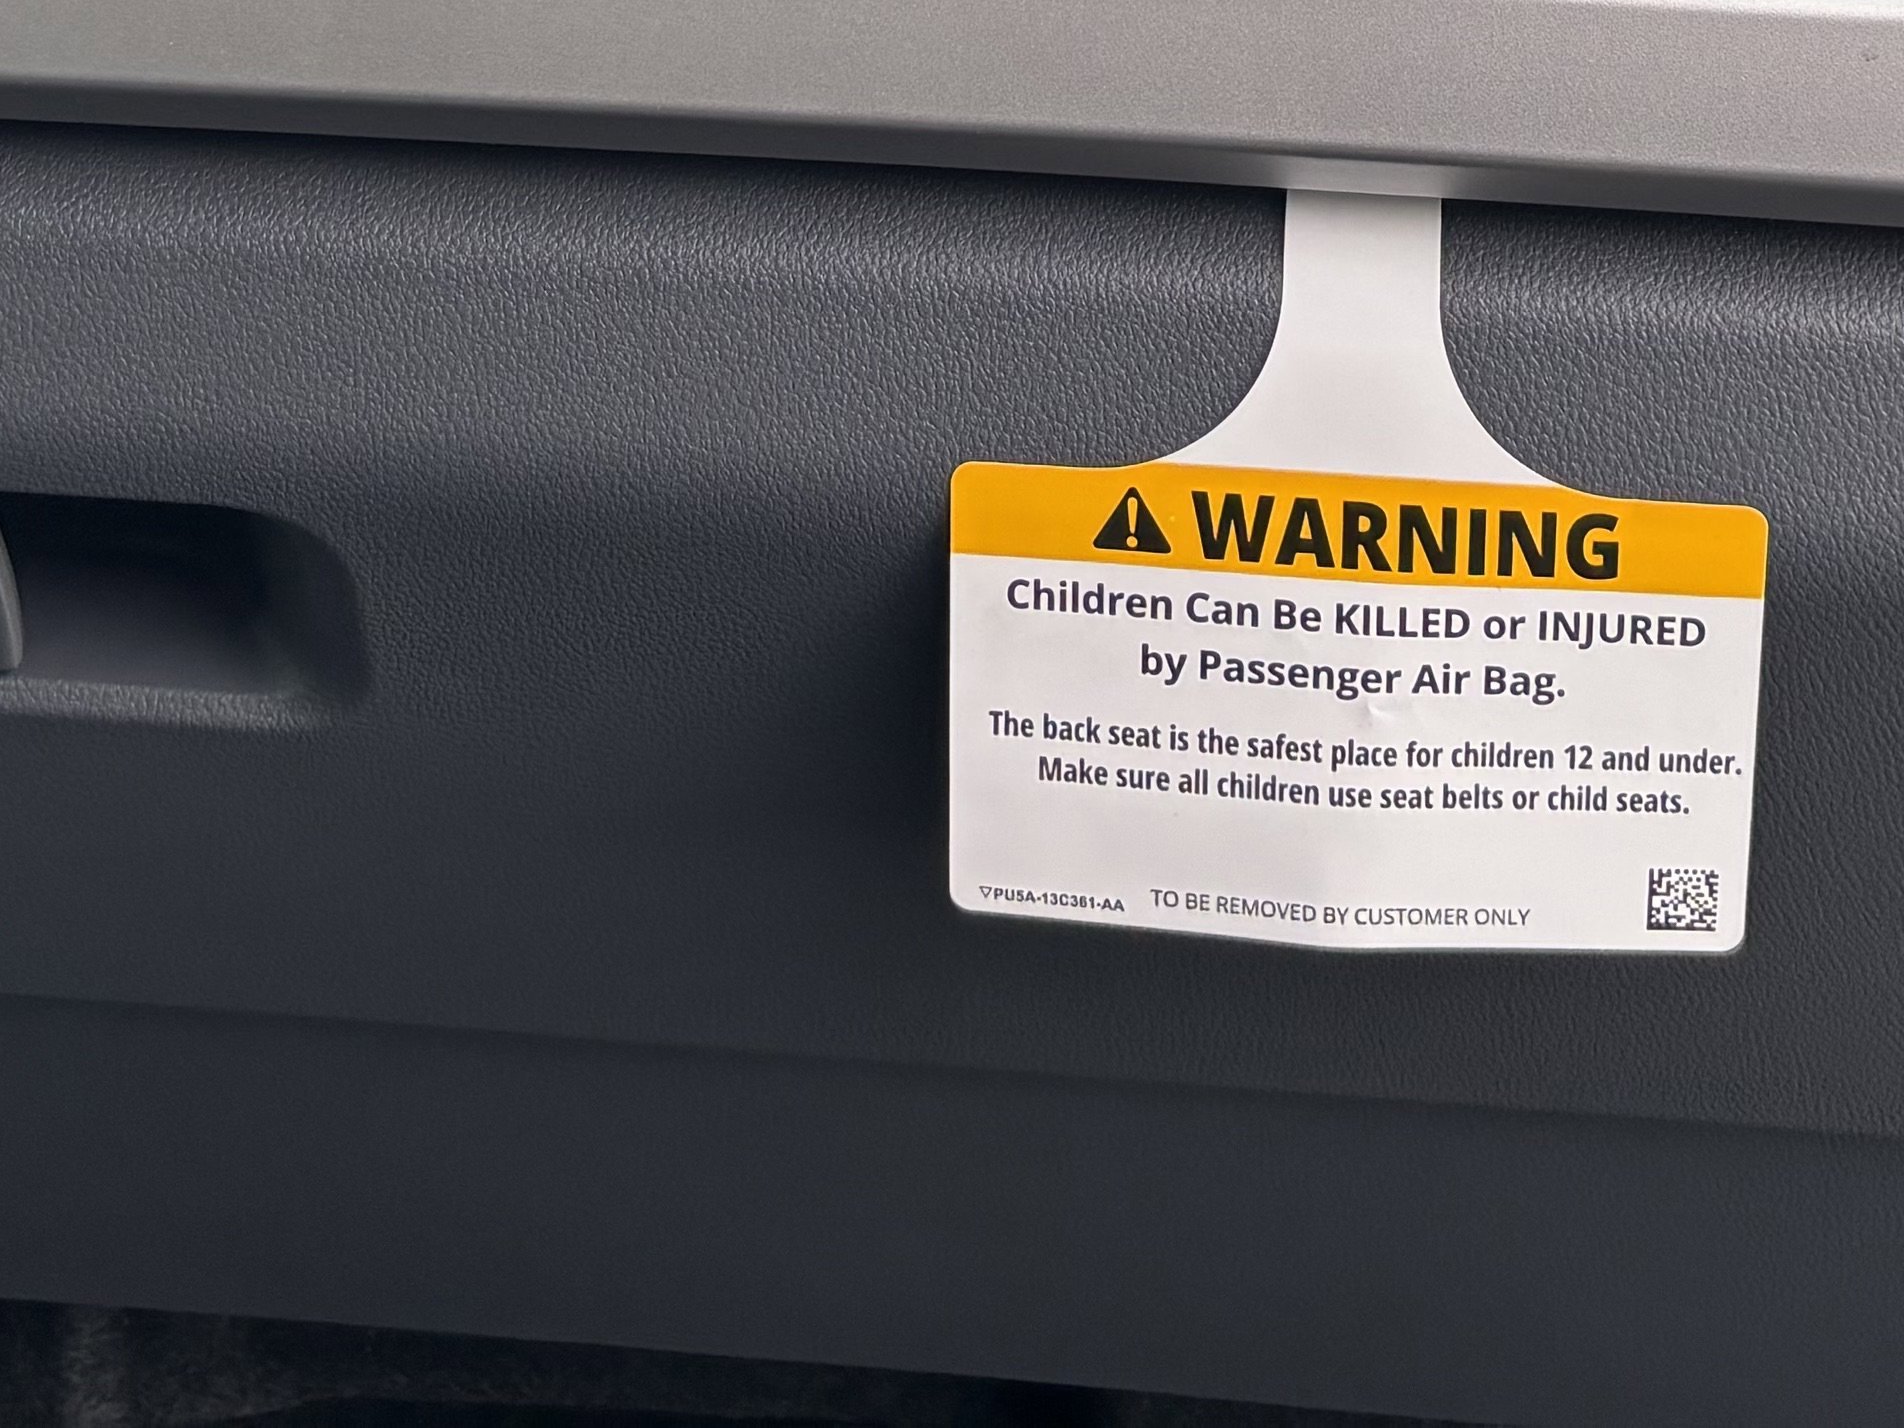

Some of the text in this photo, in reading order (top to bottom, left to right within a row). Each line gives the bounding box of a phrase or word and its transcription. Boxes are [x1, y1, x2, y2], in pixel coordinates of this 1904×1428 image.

[1190, 489, 1620, 581] WARNING
[1006, 578, 1706, 650] Children Can Be KILLED or INJURED
[1140, 642, 1566, 706] by Passenger Air Bag.
[988, 709, 1742, 776] The back seat is the safest place for children 12 and under.
[1038, 755, 1690, 815] Make sure all children use seat belts or child seats.
[1149, 888, 1531, 926] TO BE REMOVED BY CUSTOMER ONLY
